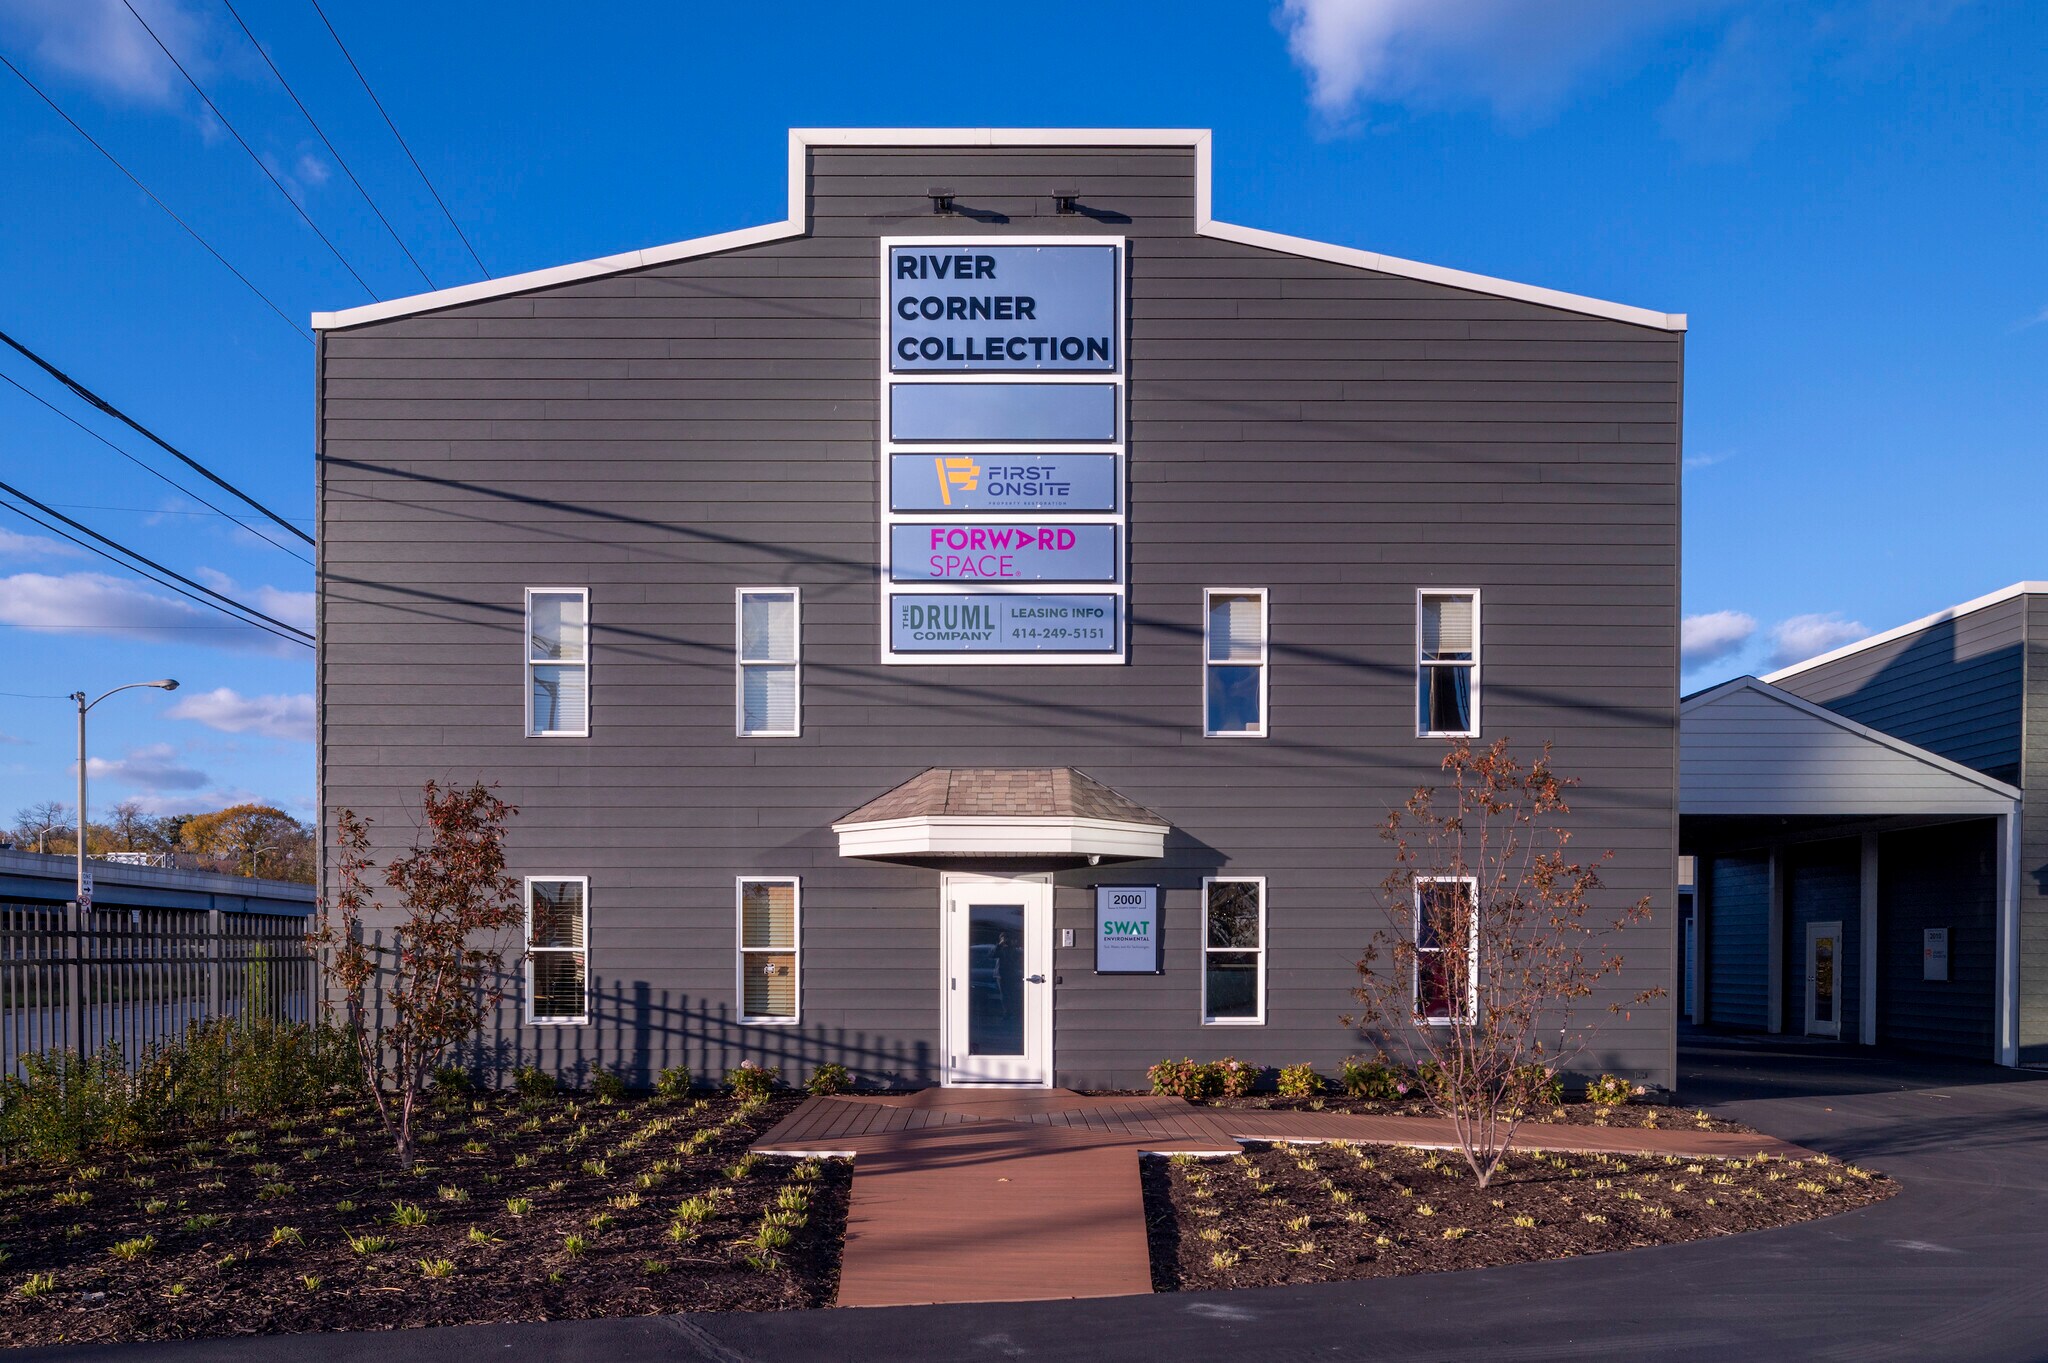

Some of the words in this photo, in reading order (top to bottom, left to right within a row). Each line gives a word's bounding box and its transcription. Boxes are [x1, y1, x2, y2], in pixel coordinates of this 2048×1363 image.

[897, 255, 996, 279] RIVER
[897, 296, 1036, 321] CORNER
[897, 336, 1109, 361] COLLECTION
[988, 466, 1056, 480] FIRST
[987, 482, 1071, 496] ONSITE
[930, 528, 1076, 550] FORWARD
[910, 604, 995, 630] DRUML
[1011, 608, 1068, 618] LEASING
[1072, 608, 1104, 618] INFO
[913, 631, 992, 641] COMPANY
[1012, 628, 1104, 639] 414-249-5151
[1113, 895, 1142, 905] 2000
[1104, 921, 1150, 935] SWAT
